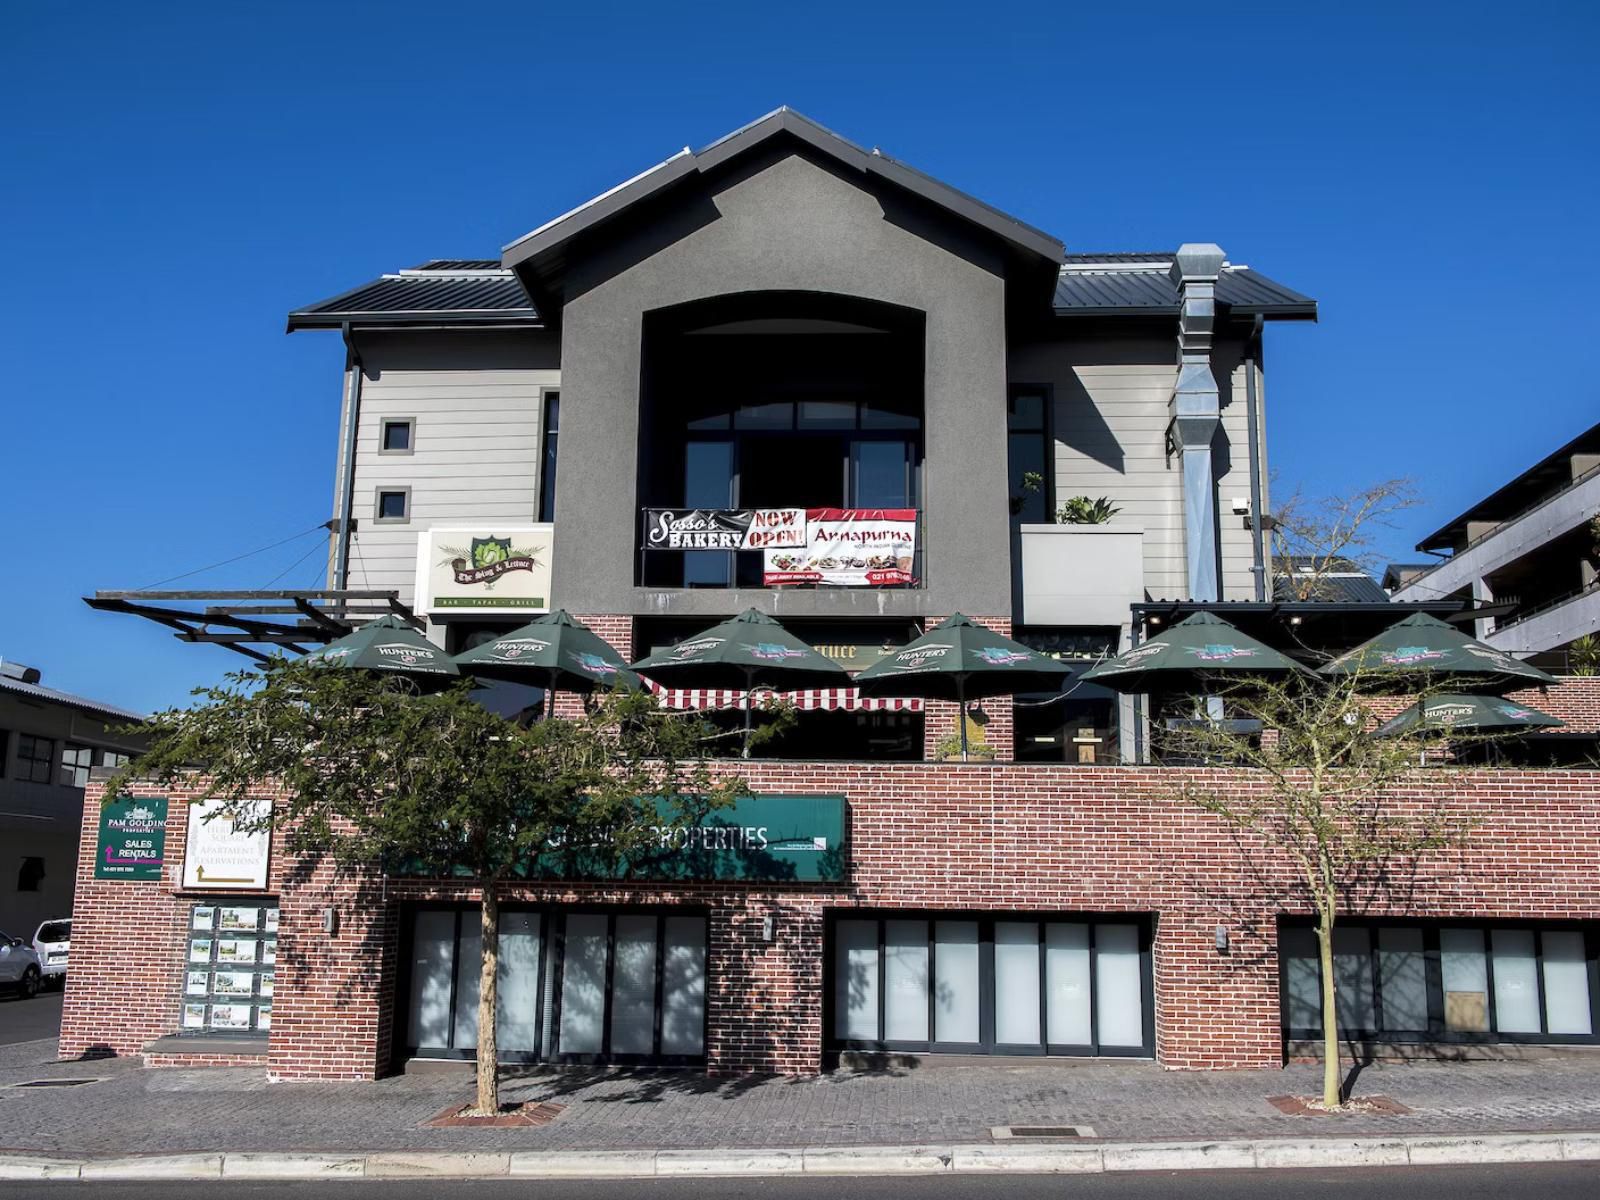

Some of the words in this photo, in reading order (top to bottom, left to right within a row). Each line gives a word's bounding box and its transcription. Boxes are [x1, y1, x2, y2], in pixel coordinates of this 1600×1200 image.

[755, 510, 797, 528] NOW
[650, 511, 720, 543] Sosso's
[669, 532, 743, 548] BAKERY
[749, 528, 804, 547] OPEN!
[108, 819, 126, 827] PAM
[125, 840, 152, 848] SALES
[119, 849, 156, 858] RENTALS
[200, 847, 256, 855] APARTMENT
[193, 857, 261, 866] RESERVATIONS
